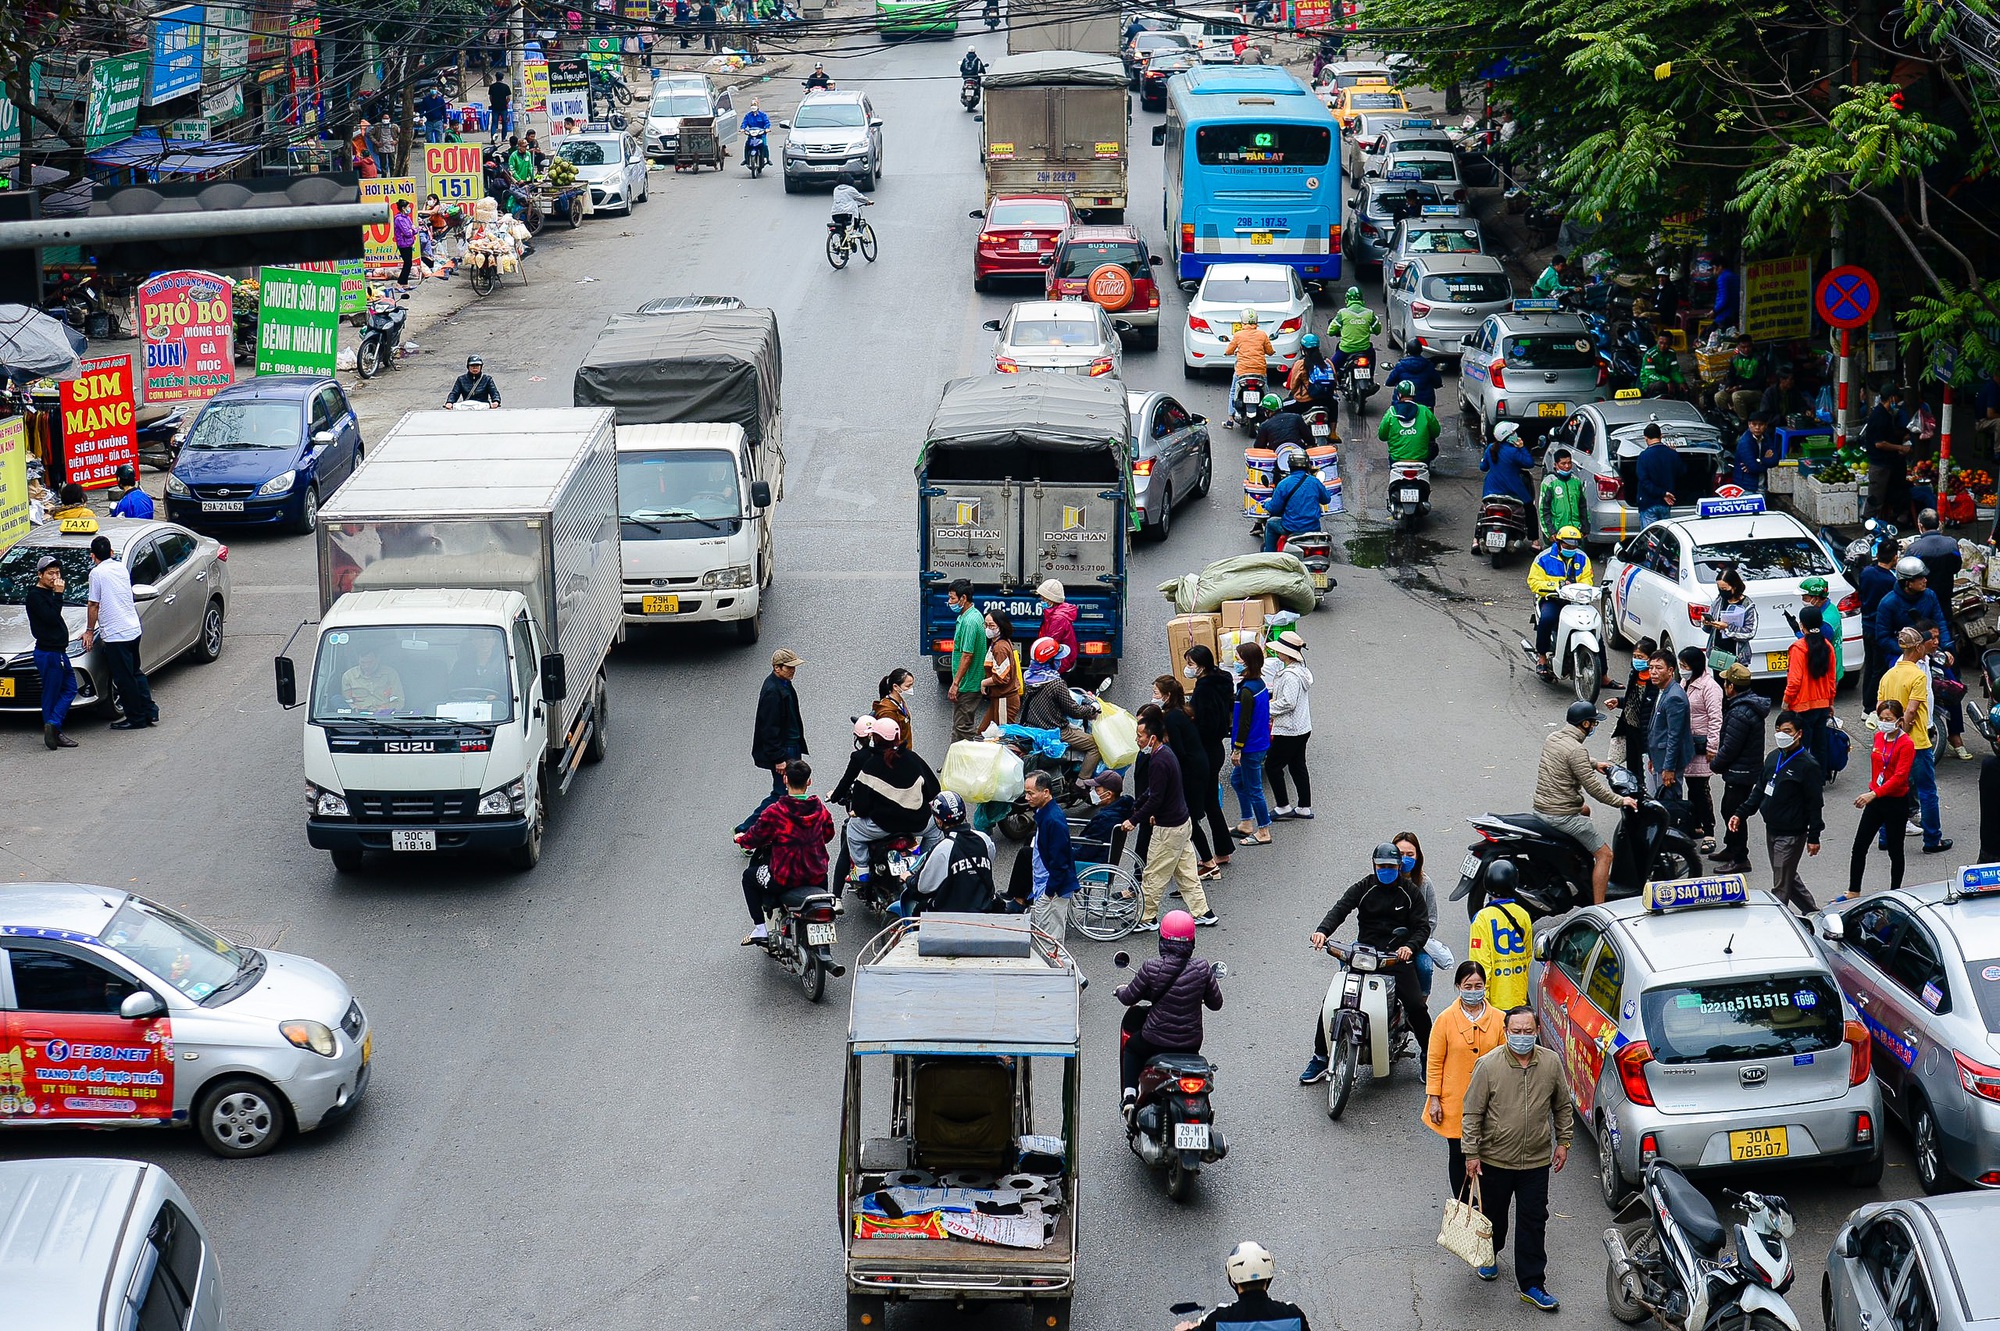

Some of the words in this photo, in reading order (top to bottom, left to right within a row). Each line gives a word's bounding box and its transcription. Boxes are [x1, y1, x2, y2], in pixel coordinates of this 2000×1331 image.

[1256, 134, 1272, 146] 62
[427, 146, 481, 174] CƠM
[365, 184, 381, 196] HƠI
[383, 181, 396, 195] HÀ
[398, 180, 415, 197] NỘI
[438, 178, 472, 198] 151
[1237, 218, 1253, 227] 29B
[1261, 218, 1288, 227] 197.52
[204, 280, 223, 293] MINH
[300, 280, 317, 312] SỮA
[318, 286, 337, 313] CHO
[144, 292, 191, 327] PHỞ
[196, 294, 228, 324] BÒ
[1350, 316, 1366, 325] Grab
[184, 325, 213, 338] MÓNG
[214, 322, 231, 336] GIÒ
[262, 318, 292, 356] BỆNH
[292, 322, 323, 354] NHÂN
[324, 328, 333, 355] K
[146, 337, 181, 368] BÚN
[200, 340, 217, 355] GÀ
[197, 360, 222, 373] MỌC
[260, 362, 273, 372] ĐT:
[274, 364, 296, 374] 0984
[149, 372, 185, 388] MIẾN
[188, 374, 230, 386] NGAN
[72, 372, 121, 402] SIM
[164, 390, 183, 399] RANG
[1622, 390, 1639, 398] TAXI
[66, 402, 133, 438] MẠNG
[1400, 428, 1417, 437] Grab
[74, 439, 96, 454] SIÊU
[97, 434, 129, 449] KHỦNG
[68, 455, 84, 470] ĐIỆN
[84, 452, 104, 467] THOẠI
[73, 467, 91, 483] GIÁ
[94, 464, 118, 480] SIÊU
[202, 502, 244, 511] 29A-214.62
[64, 520, 90, 529] TAXI
[974, 530, 1000, 538] HAN
[1044, 532, 1078, 541] DONG
[1082, 533, 1107, 541] HAN
[1056, 564, 1106, 572] 090.215.7100
[646, 604, 675, 612] 712.83
[384, 742, 436, 753] ISUZU
[404, 832, 423, 841] 90C
[398, 841, 432, 851] 118.18
[1678, 886, 1700, 900] SAO
[1702, 882, 1723, 896] THỦ
[1725, 880, 1741, 895] ĐÔ
[1694, 896, 1723, 904] GROUP
[1490, 918, 1526, 955] be
[1794, 994, 1816, 1006] 1696
[70, 1044, 151, 1062] EE88.NET
[36, 1068, 70, 1080] TRANG
[88, 1067, 105, 1081] SỐ
[105, 1072, 132, 1085] TRỰC
[132, 1070, 164, 1085] TUYẾN
[1746, 1070, 1763, 1079] KIA
[42, 1084, 56, 1094] UY
[59, 1084, 77, 1095] TÍN
[132, 1087, 157, 1100] HIỆU
[1746, 1132, 1771, 1144] 30A
[1737, 1143, 1782, 1159] 785.07
